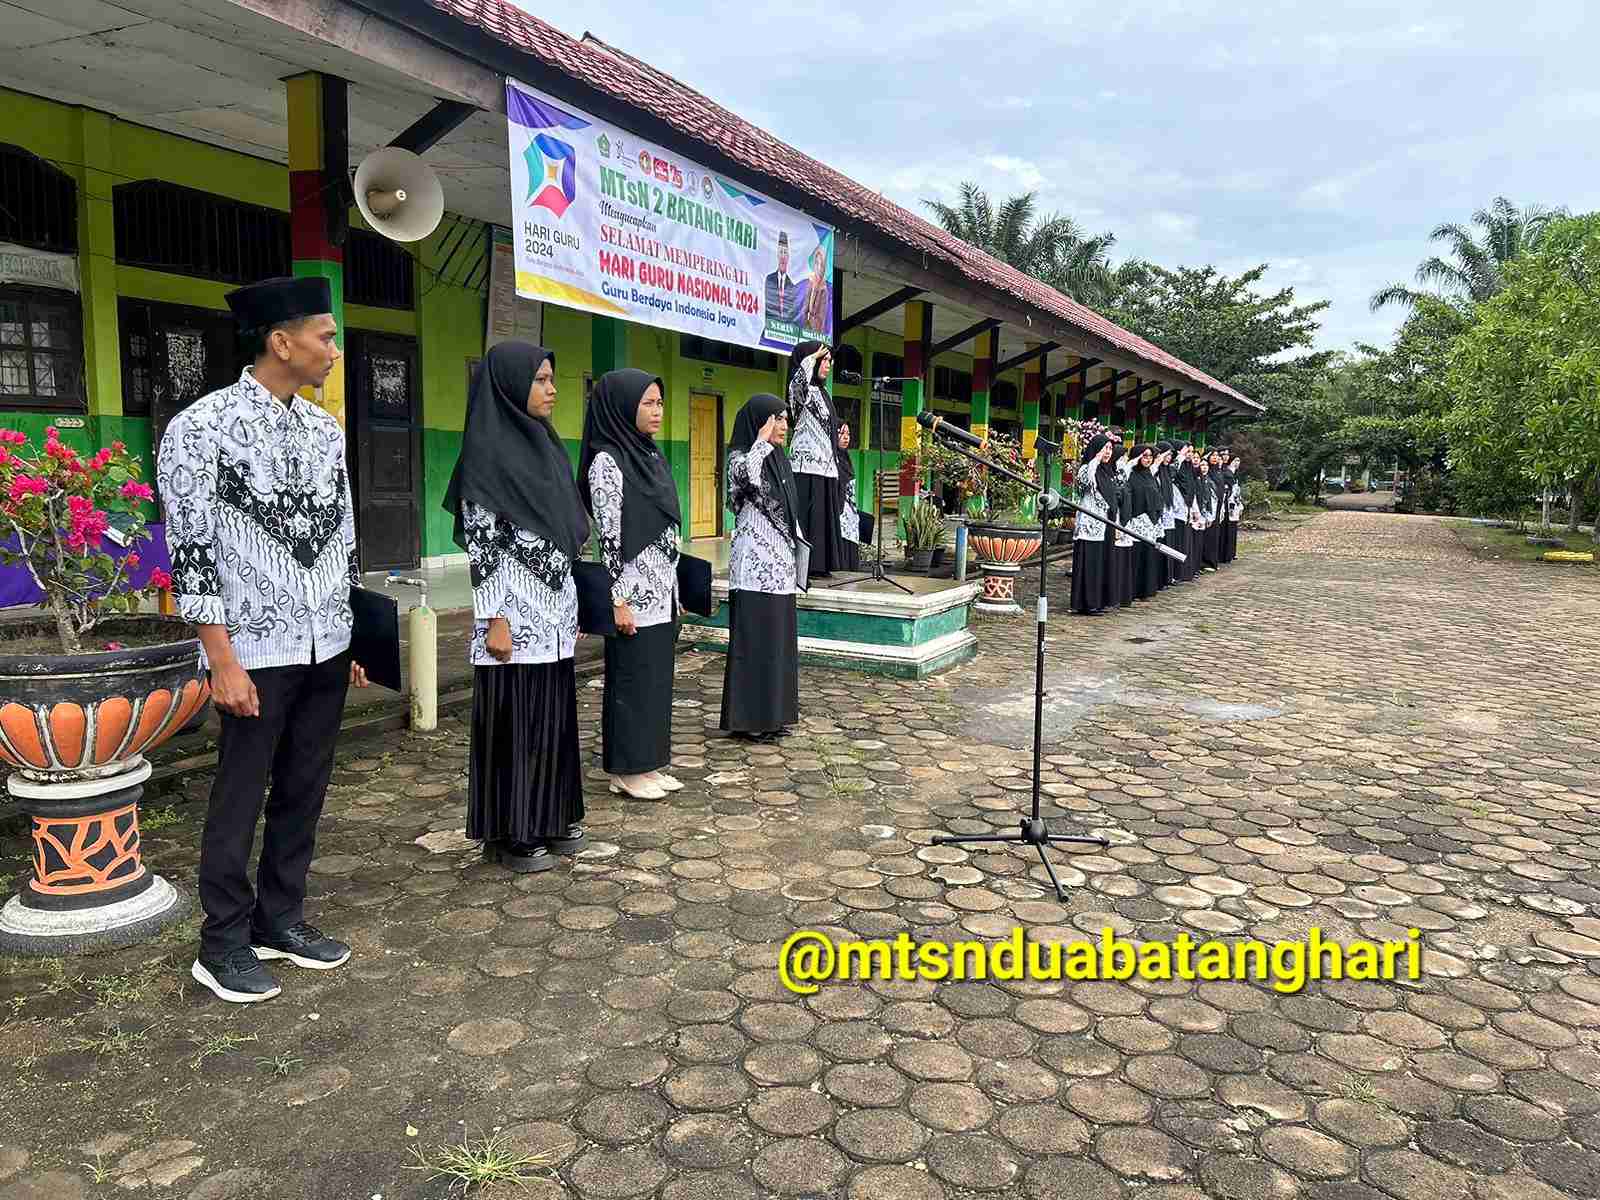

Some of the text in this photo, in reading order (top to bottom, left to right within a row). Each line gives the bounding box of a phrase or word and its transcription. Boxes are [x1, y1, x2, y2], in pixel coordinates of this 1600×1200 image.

[524, 220, 580, 250] HARI GURU
[599, 200, 657, 233] Mengucapkan
[653, 186, 663, 215] 2
[666, 191, 722, 238] BATANG
[727, 215, 758, 250] HARI
[525, 238, 553, 258] 2024
[600, 223, 749, 287] SELAMAT MEMPERINGATI
[599, 249, 635, 282] HARI
[639, 261, 674, 292] GURU
[677, 271, 733, 308] NASIONAL
[735, 289, 759, 315] 2024
[601, 281, 629, 300] Guru
[630, 288, 673, 313] Berdaya
[718, 310, 737, 328] Jaya
